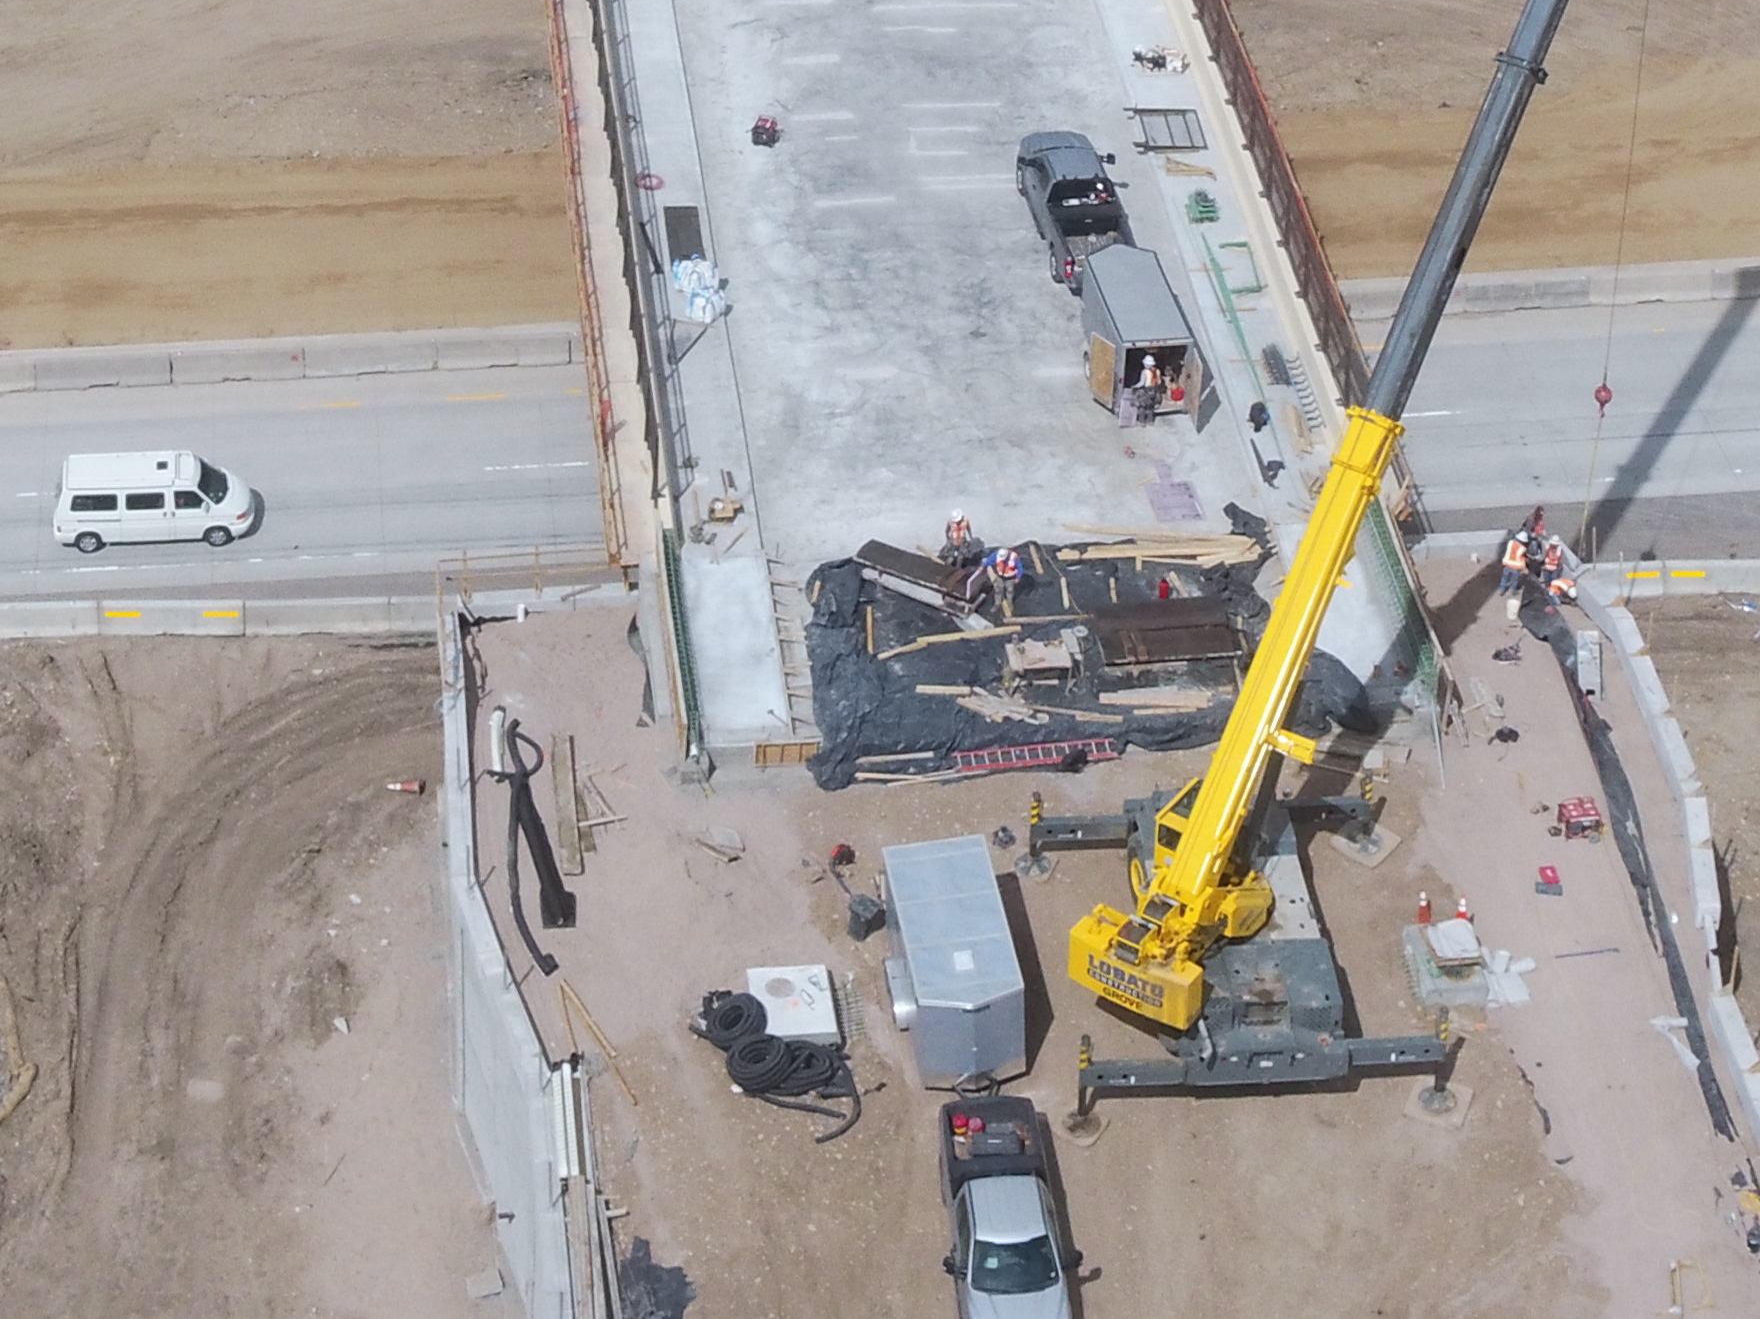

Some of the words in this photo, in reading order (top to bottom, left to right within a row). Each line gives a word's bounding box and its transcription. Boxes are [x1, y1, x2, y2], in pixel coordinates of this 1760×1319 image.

[1087, 968, 1163, 1008] CONSTRUCTION
[1088, 953, 1164, 998] LOBATO
[1102, 986, 1143, 1010] GROVE
